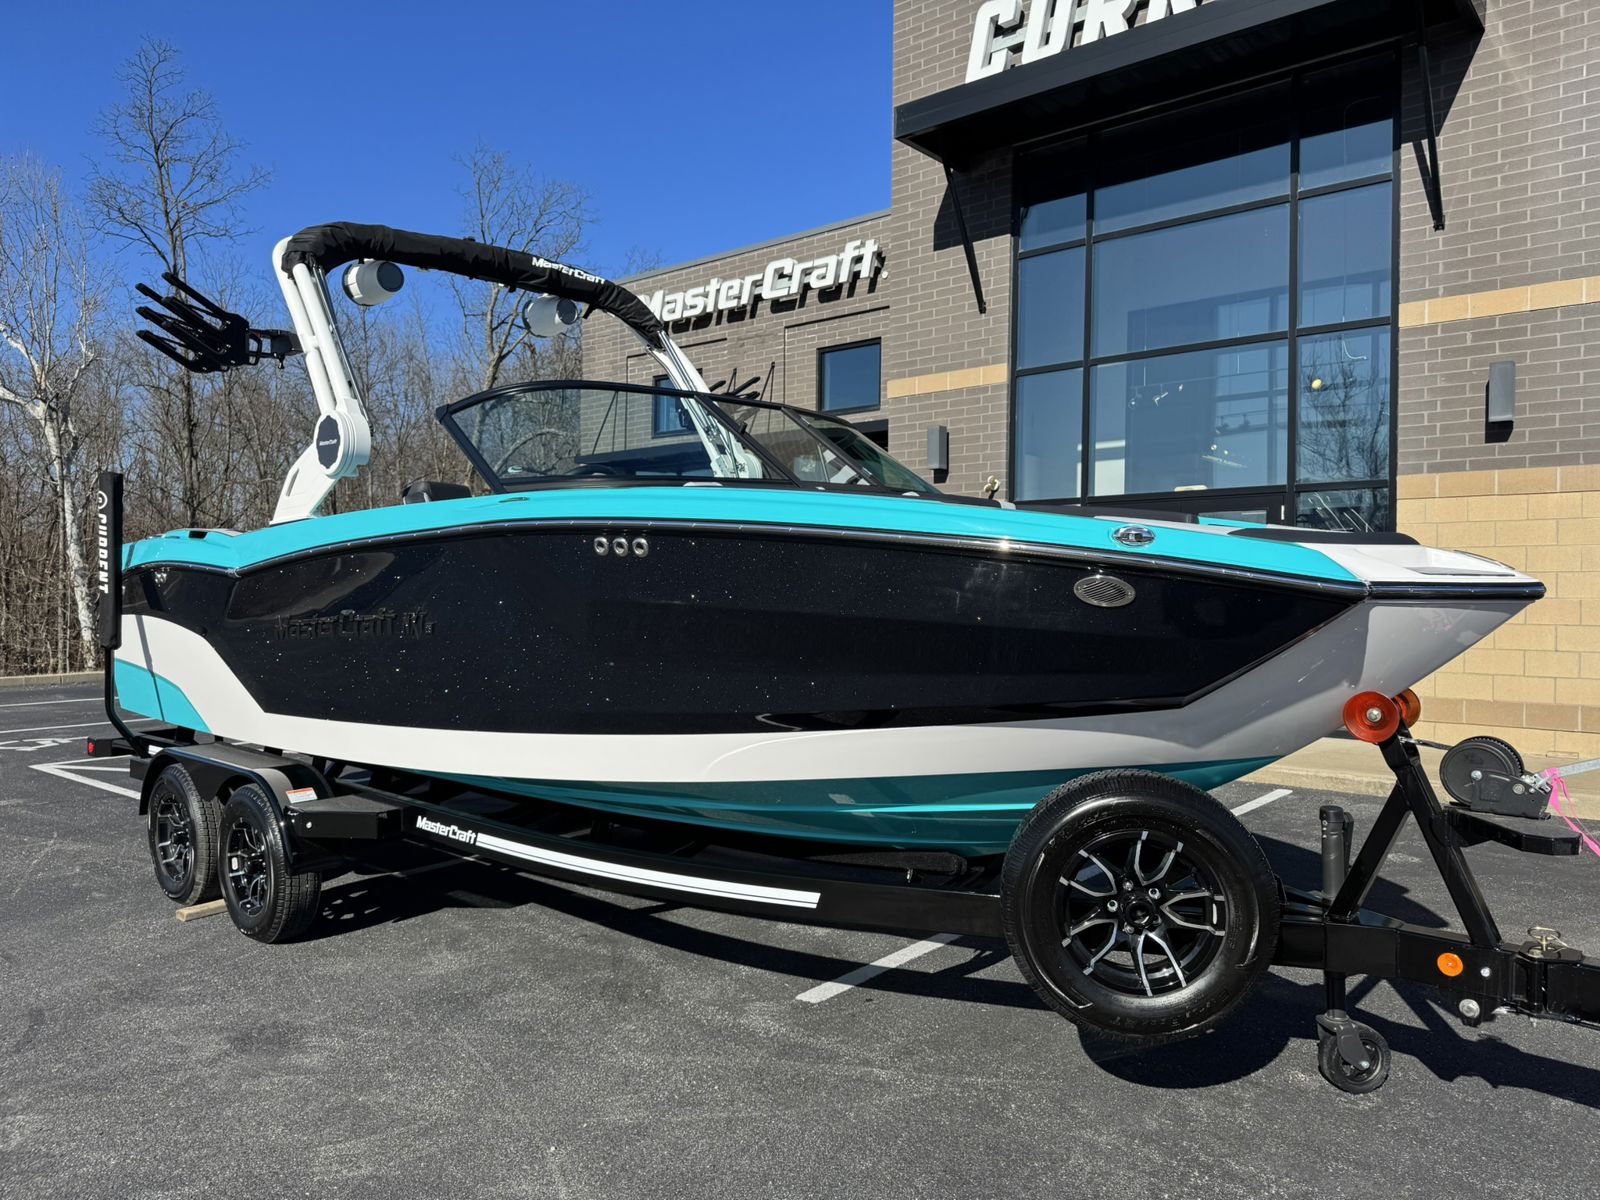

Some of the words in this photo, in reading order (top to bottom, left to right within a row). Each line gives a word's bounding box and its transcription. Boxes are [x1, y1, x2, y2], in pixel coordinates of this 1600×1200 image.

[965, 0, 1197, 83] CUR
[531, 256, 605, 284] MasterCraft
[416, 815, 476, 844] MasterCraft
